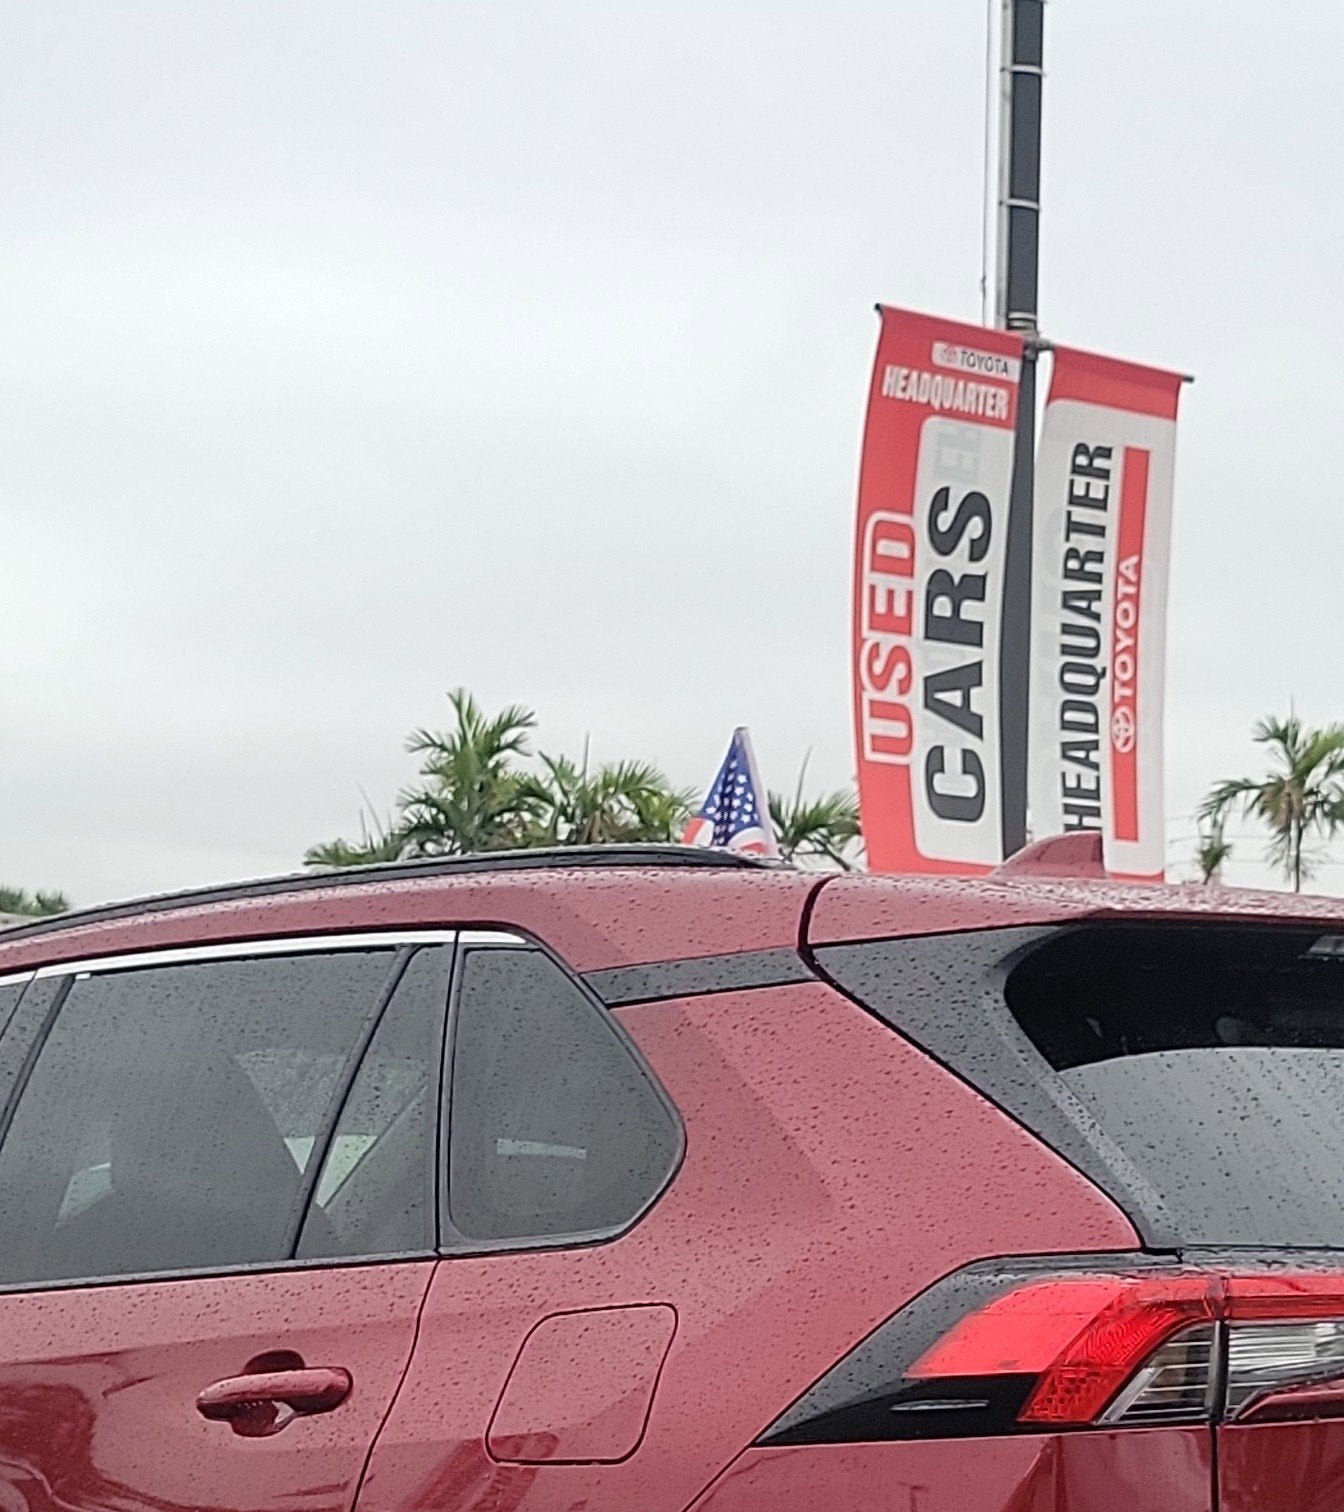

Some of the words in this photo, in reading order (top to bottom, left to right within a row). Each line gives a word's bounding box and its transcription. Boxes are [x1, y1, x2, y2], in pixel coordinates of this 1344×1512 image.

[882, 364, 1009, 421] HEADQUARTER
[960, 350, 1009, 376] TOYOTA
[861, 512, 915, 764] USED
[922, 484, 993, 824] CARS
[1059, 441, 1115, 833] HEADQUARTER
[1114, 554, 1141, 703] TOYOTA
